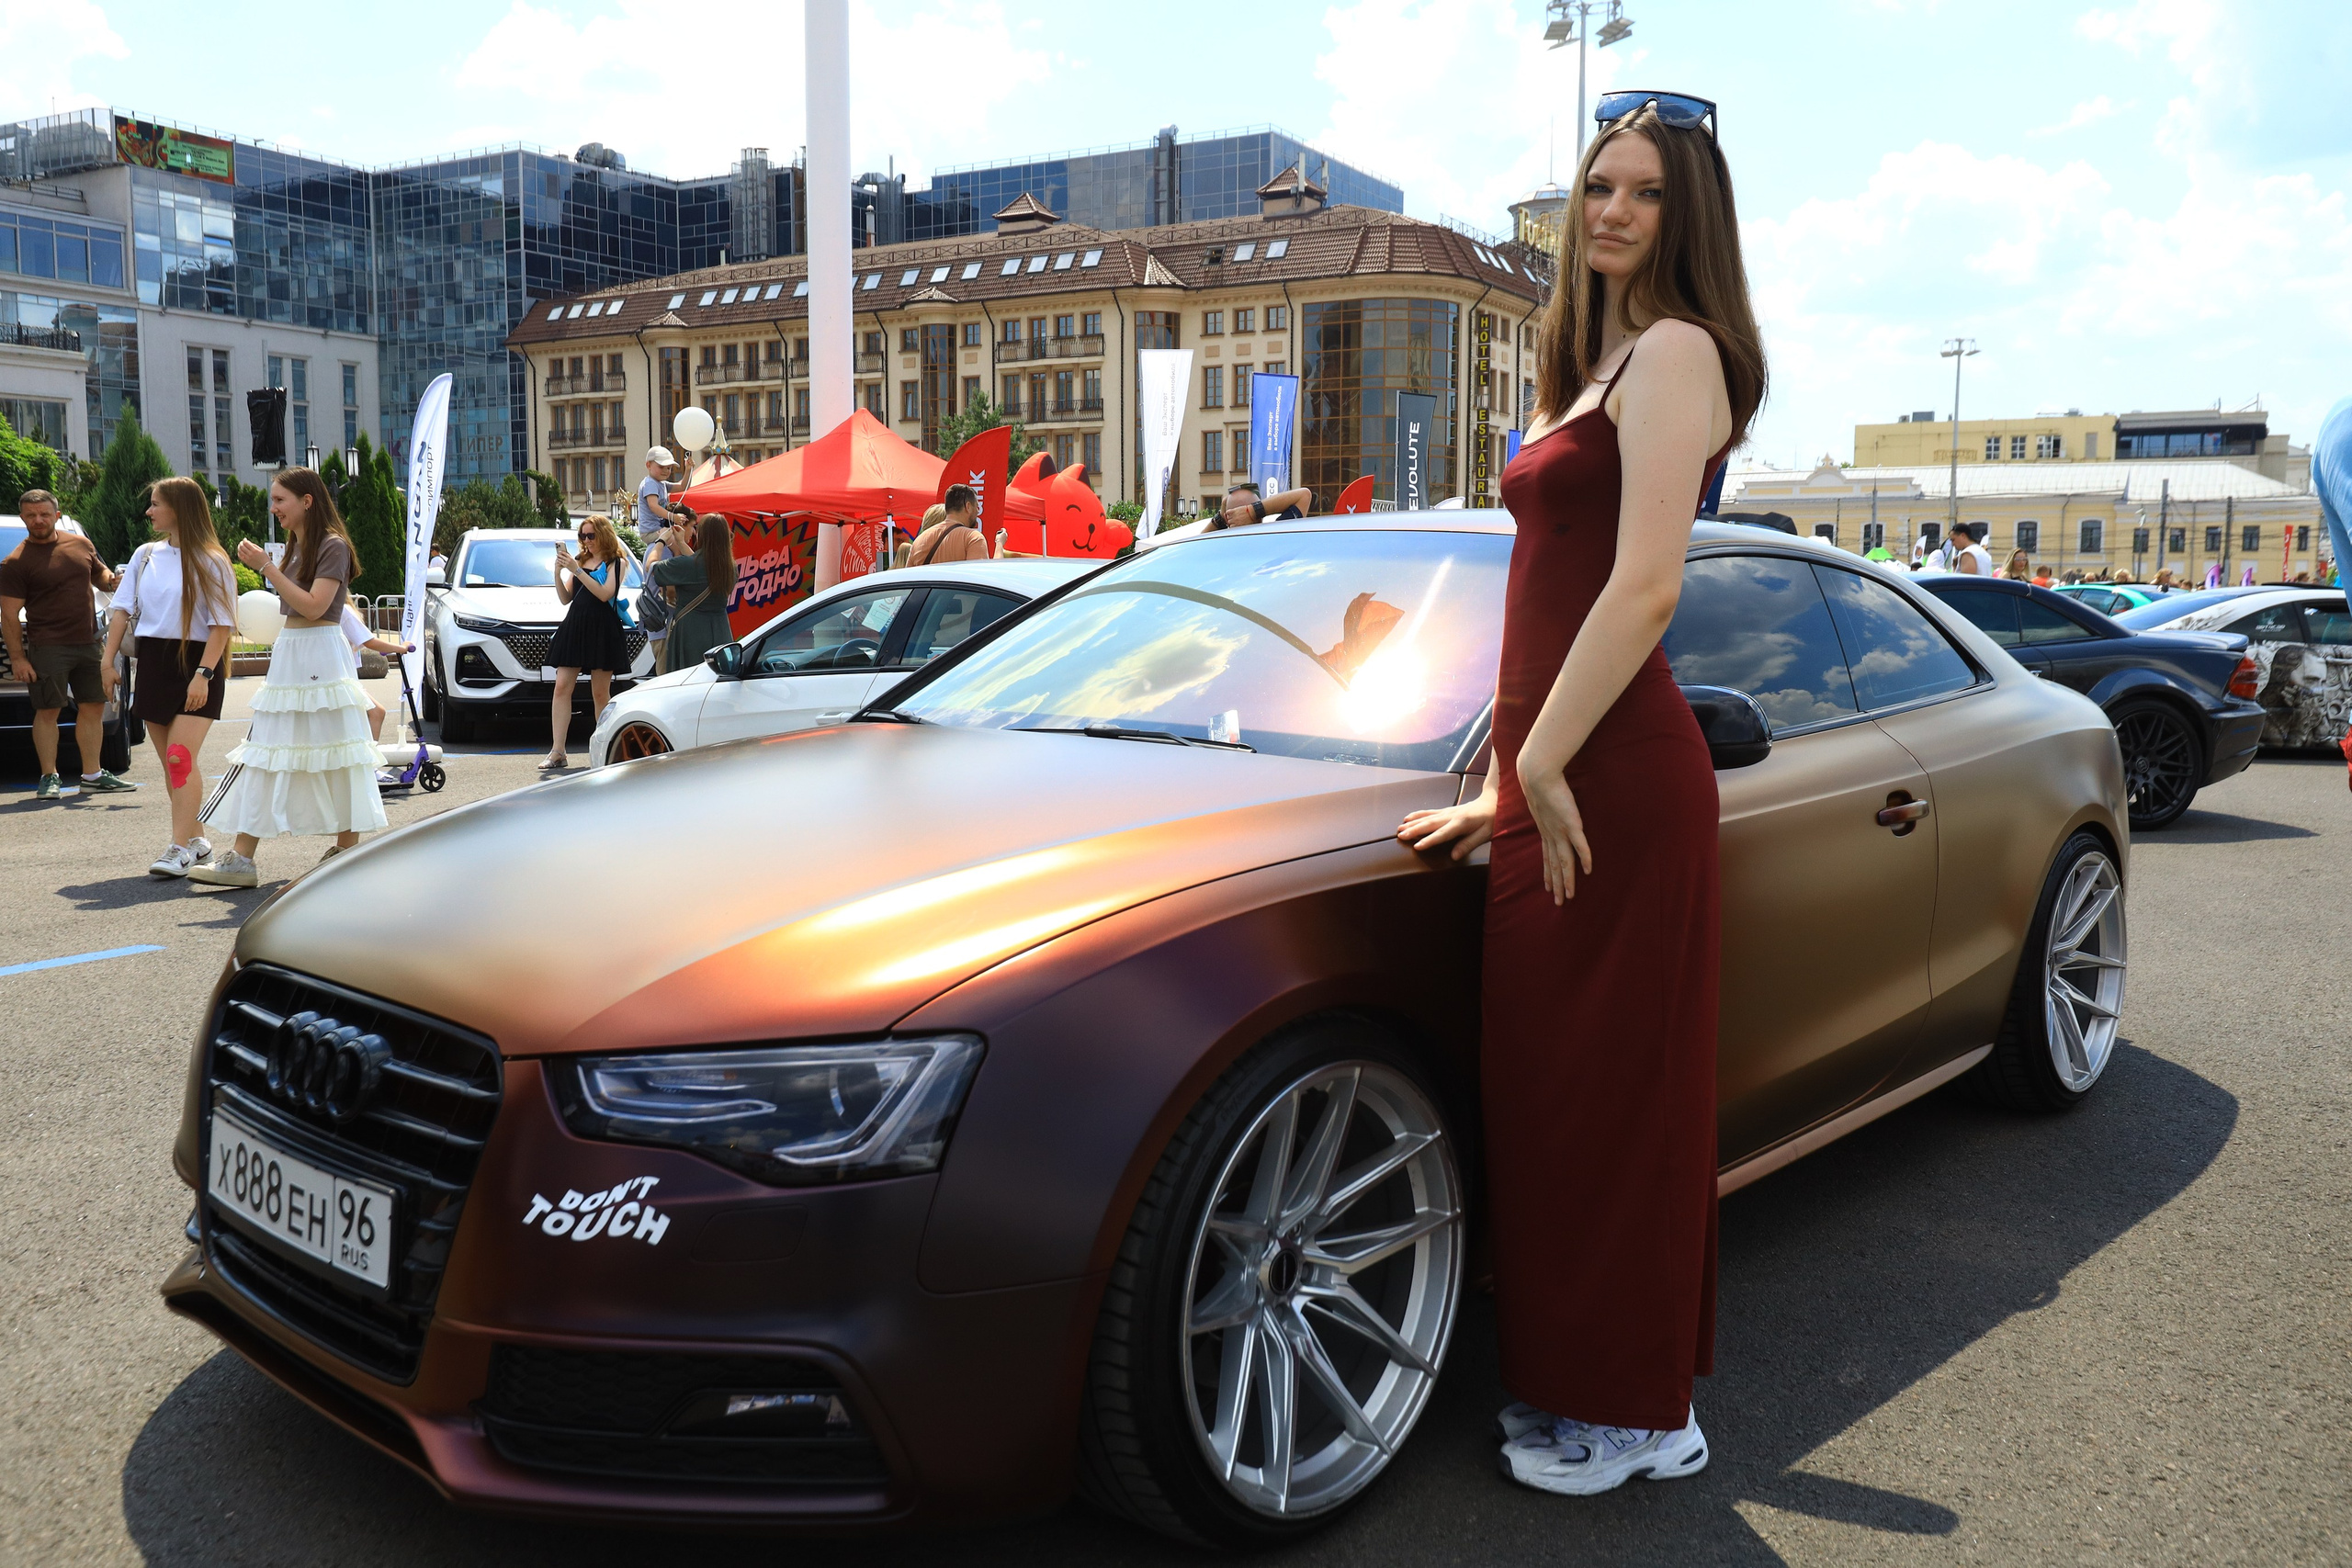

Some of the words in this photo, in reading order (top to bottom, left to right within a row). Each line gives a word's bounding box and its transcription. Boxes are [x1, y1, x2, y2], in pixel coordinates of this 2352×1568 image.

[1479, 317, 1488, 385] HOTEL
[1274, 386, 1283, 423] автомобиля
[1408, 421, 1420, 511] EVOLUTE
[735, 545, 790, 580] ЛЬФА
[843, 545, 867, 573] СТИЛЬ
[727, 563, 801, 607] ГОДНО
[558, 1175, 661, 1213] DON'T
[338, 1188, 376, 1247] 96
[521, 1191, 672, 1247] TOUCH
[341, 1242, 370, 1270] RUS
